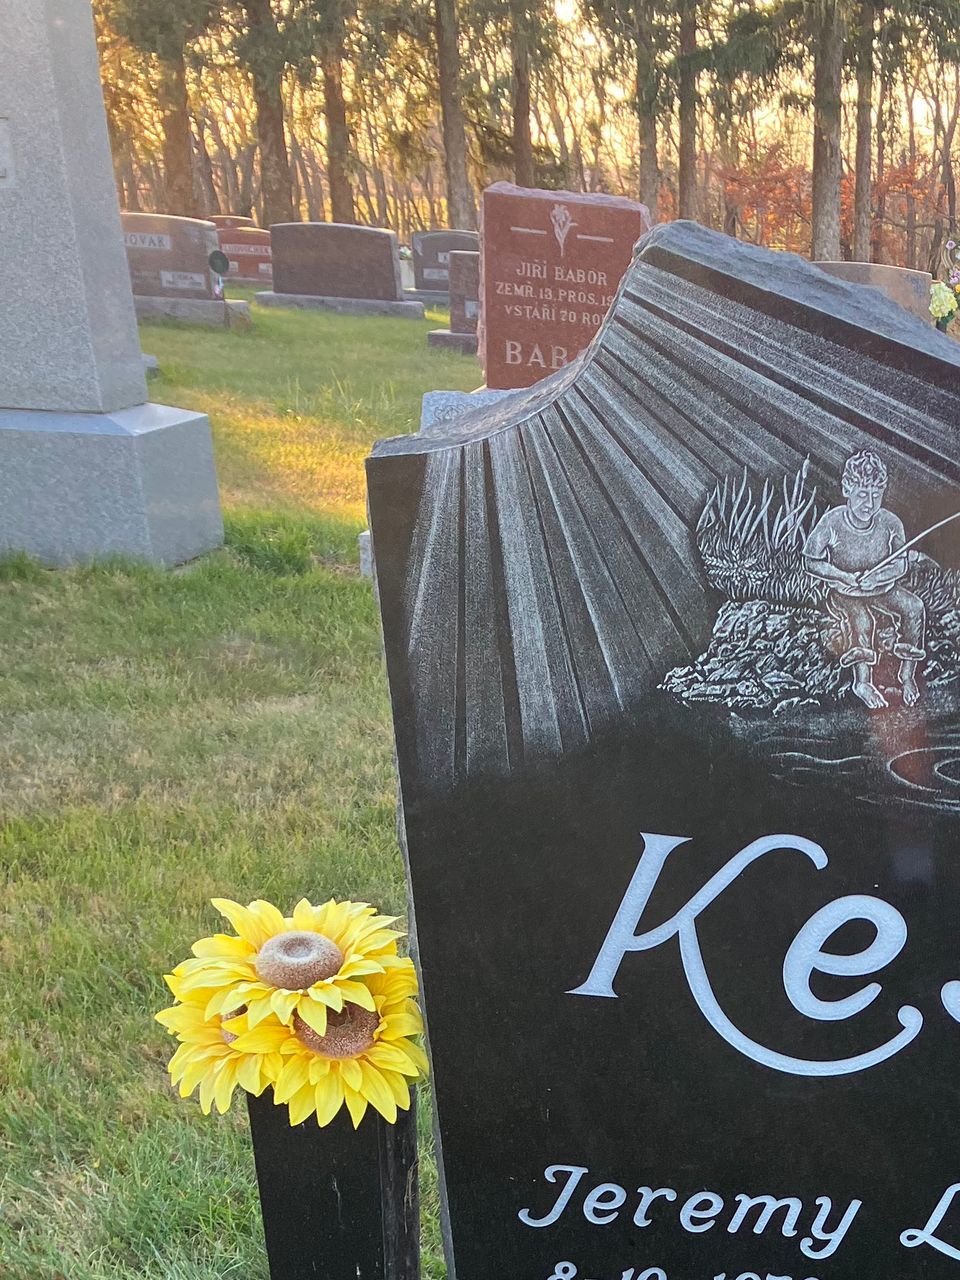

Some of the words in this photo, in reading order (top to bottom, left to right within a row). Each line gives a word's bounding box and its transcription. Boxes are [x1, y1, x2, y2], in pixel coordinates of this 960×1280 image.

[554, 266, 608, 286] BABOR
[505, 339, 569, 369] BAB
[518, 1165, 863, 1260] Jeremy
